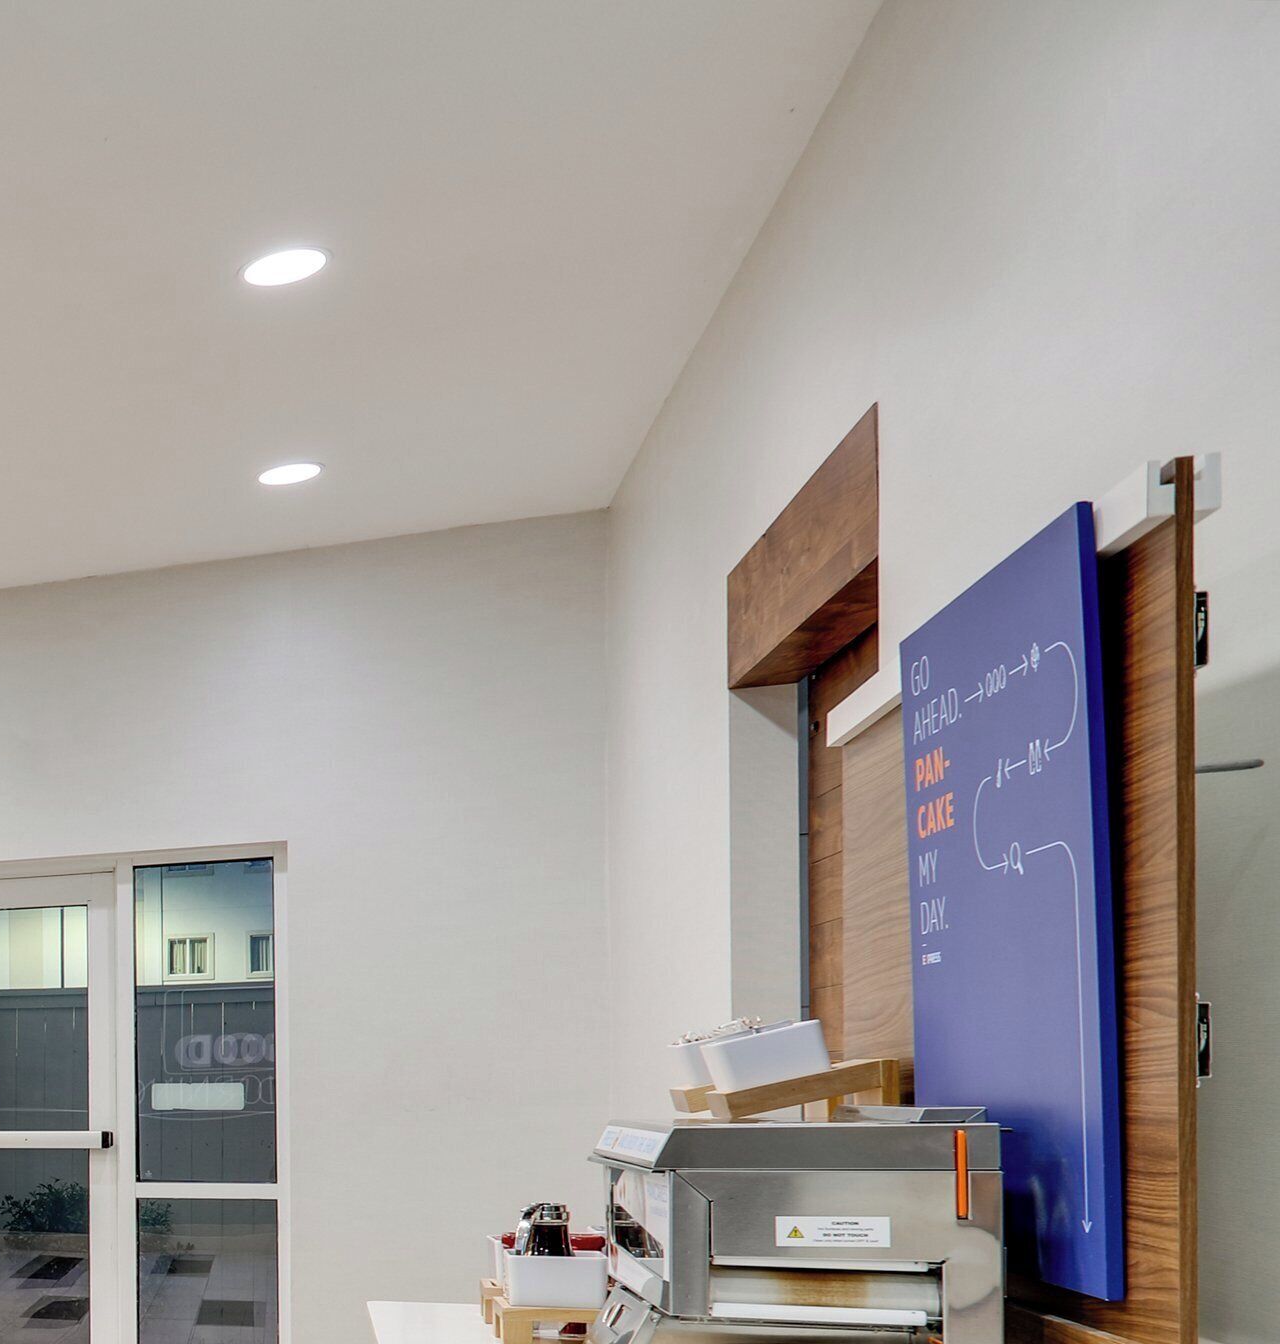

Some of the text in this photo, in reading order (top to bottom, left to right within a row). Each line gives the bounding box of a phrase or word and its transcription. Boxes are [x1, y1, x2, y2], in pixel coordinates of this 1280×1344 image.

[910, 655, 930, 697] GO
[913, 687, 963, 745] AHEAD.
[914, 746, 951, 792] PAN-
[917, 791, 955, 840] CAKE
[918, 848, 939, 888] MY
[920, 895, 949, 936] DAY.
